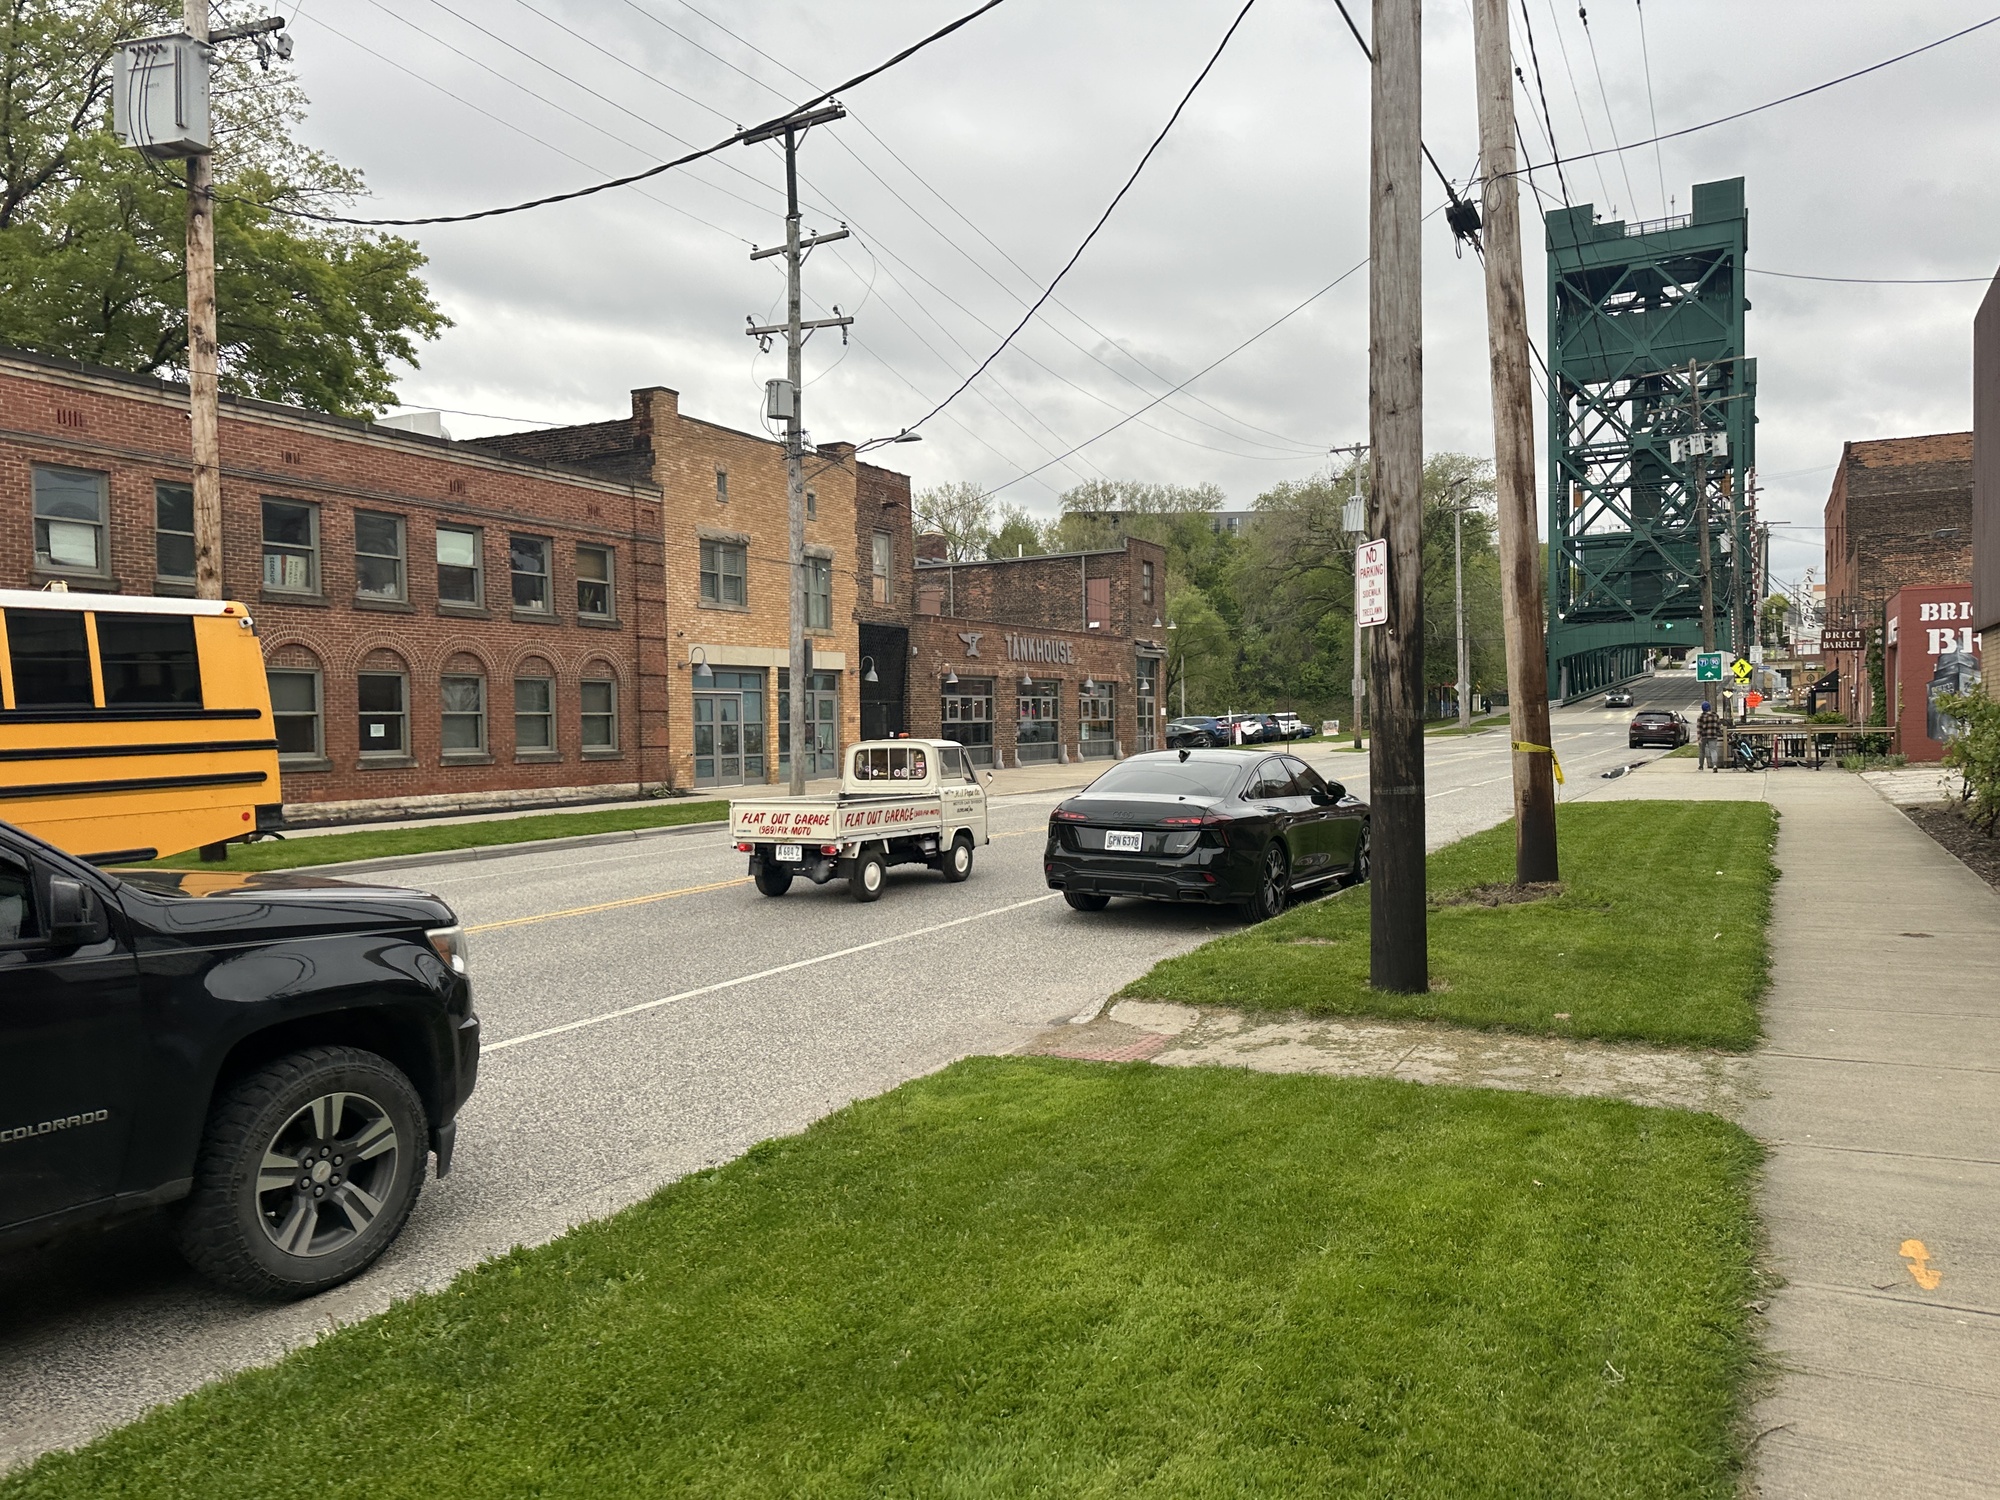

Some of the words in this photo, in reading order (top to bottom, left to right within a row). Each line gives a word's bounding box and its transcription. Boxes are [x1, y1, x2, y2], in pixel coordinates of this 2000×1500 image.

[1366, 549, 1377, 564] NO
[1360, 564, 1383, 579] PARKING
[1363, 587, 1381, 598] SIDEWALK
[1369, 598, 1375, 606] OR
[1362, 606, 1382, 617] TREELAWN
[1920, 602, 1973, 621] BRI
[1825, 630, 1861, 639] BRICK
[971, 636, 976, 647] F
[1823, 641, 1863, 649] BARREL
[1005, 634, 1075, 665] TANKHOUSE
[742, 812, 766, 824] FLAT
[771, 813, 791, 825] OUT
[794, 814, 830, 826] GARAGE
[845, 811, 866, 827] FLAT
[866, 810, 883, 825] OUT
[884, 808, 914, 823] GARAGE
[758, 825, 777, 835] (989)
[1108, 836, 1121, 845] GPN
[1122, 836, 1140, 846] 6378
[0, 1109, 108, 1142] COLORADO
